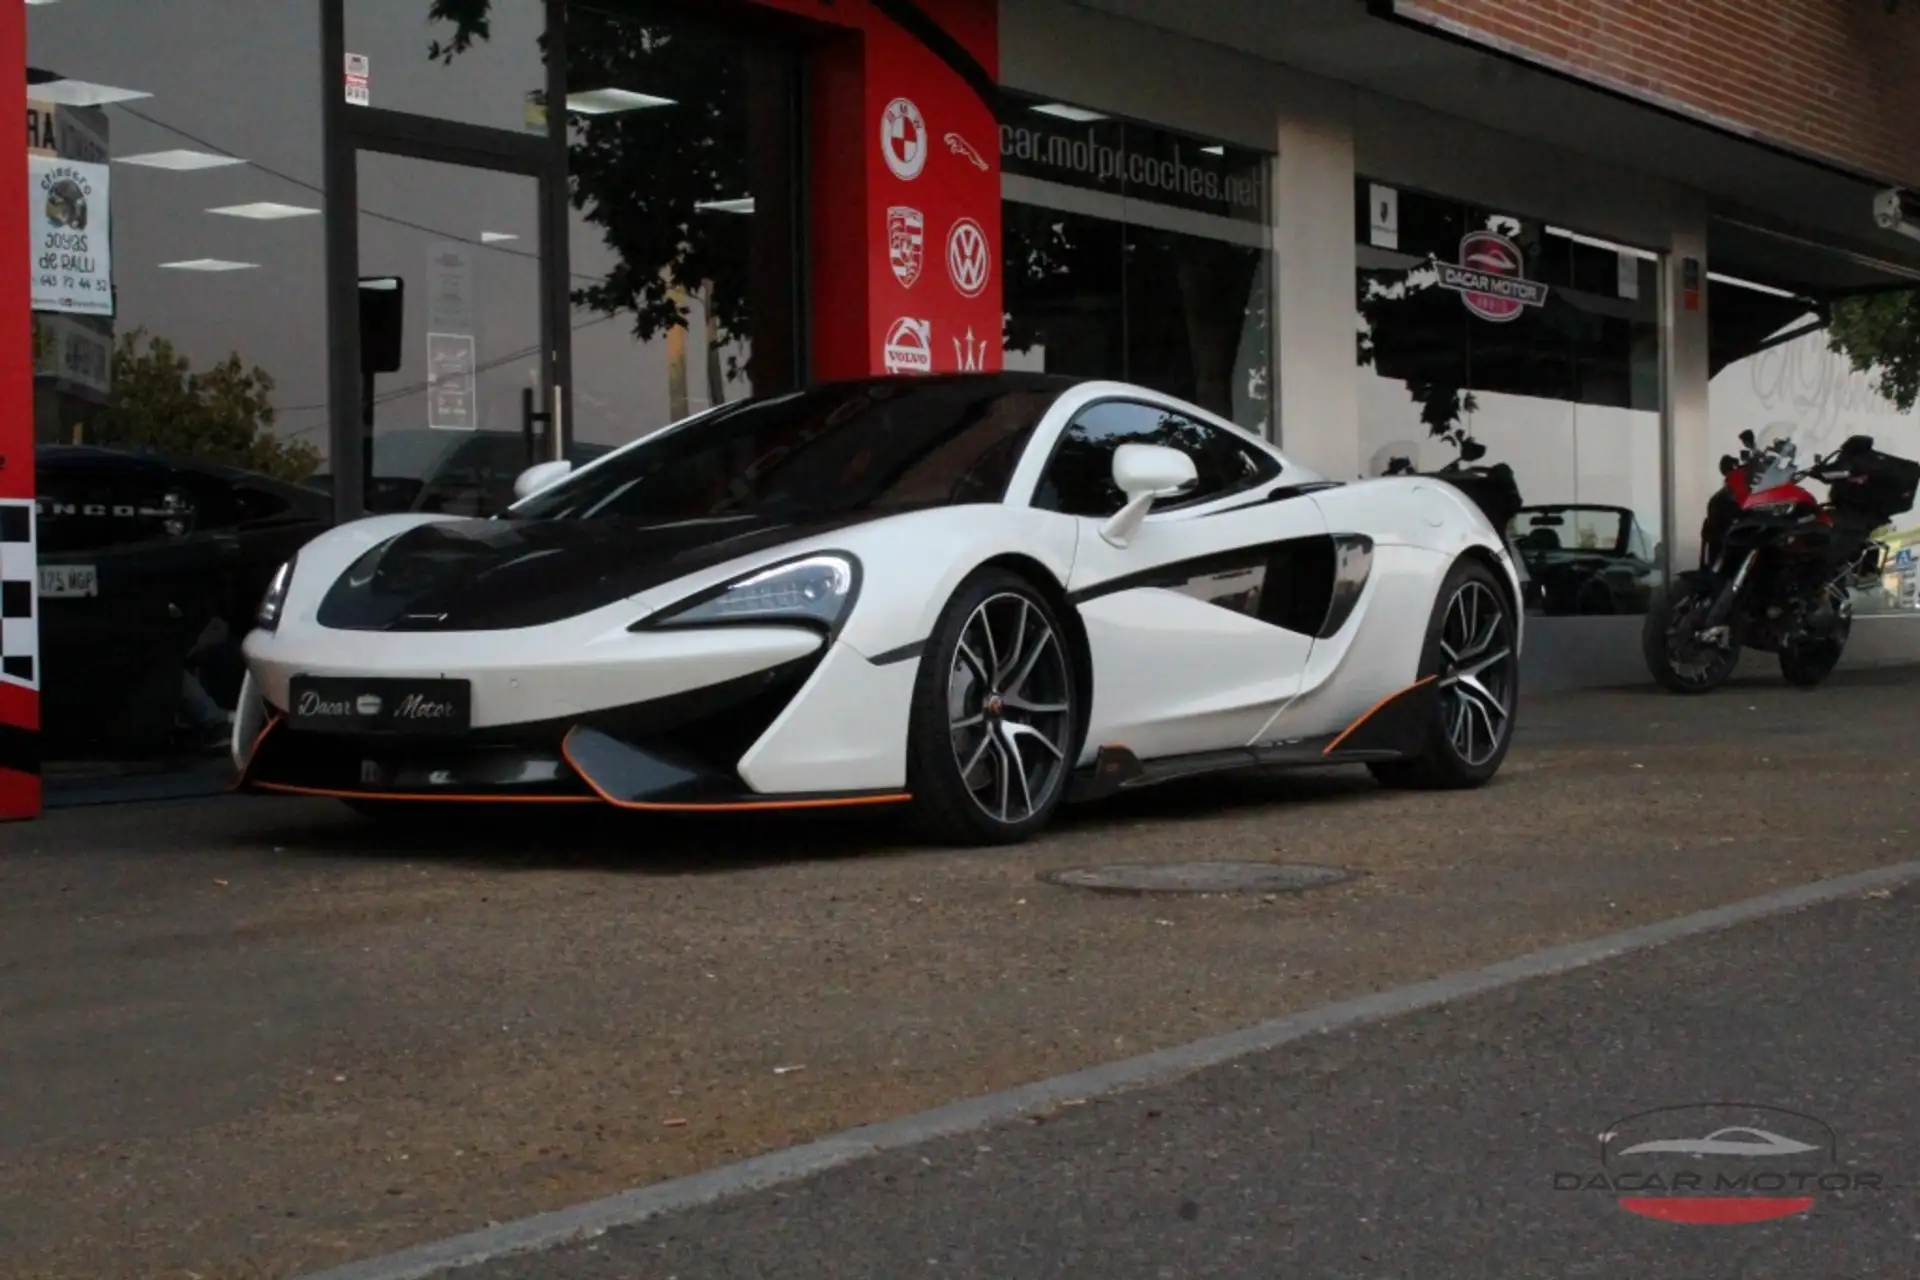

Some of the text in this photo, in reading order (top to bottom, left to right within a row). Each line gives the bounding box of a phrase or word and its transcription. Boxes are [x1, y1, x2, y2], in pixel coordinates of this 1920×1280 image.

[1445, 268, 1537, 300] DACAR MOTOR
[887, 350, 928, 365] VOLVO
[298, 691, 457, 719] Dacar Motor
